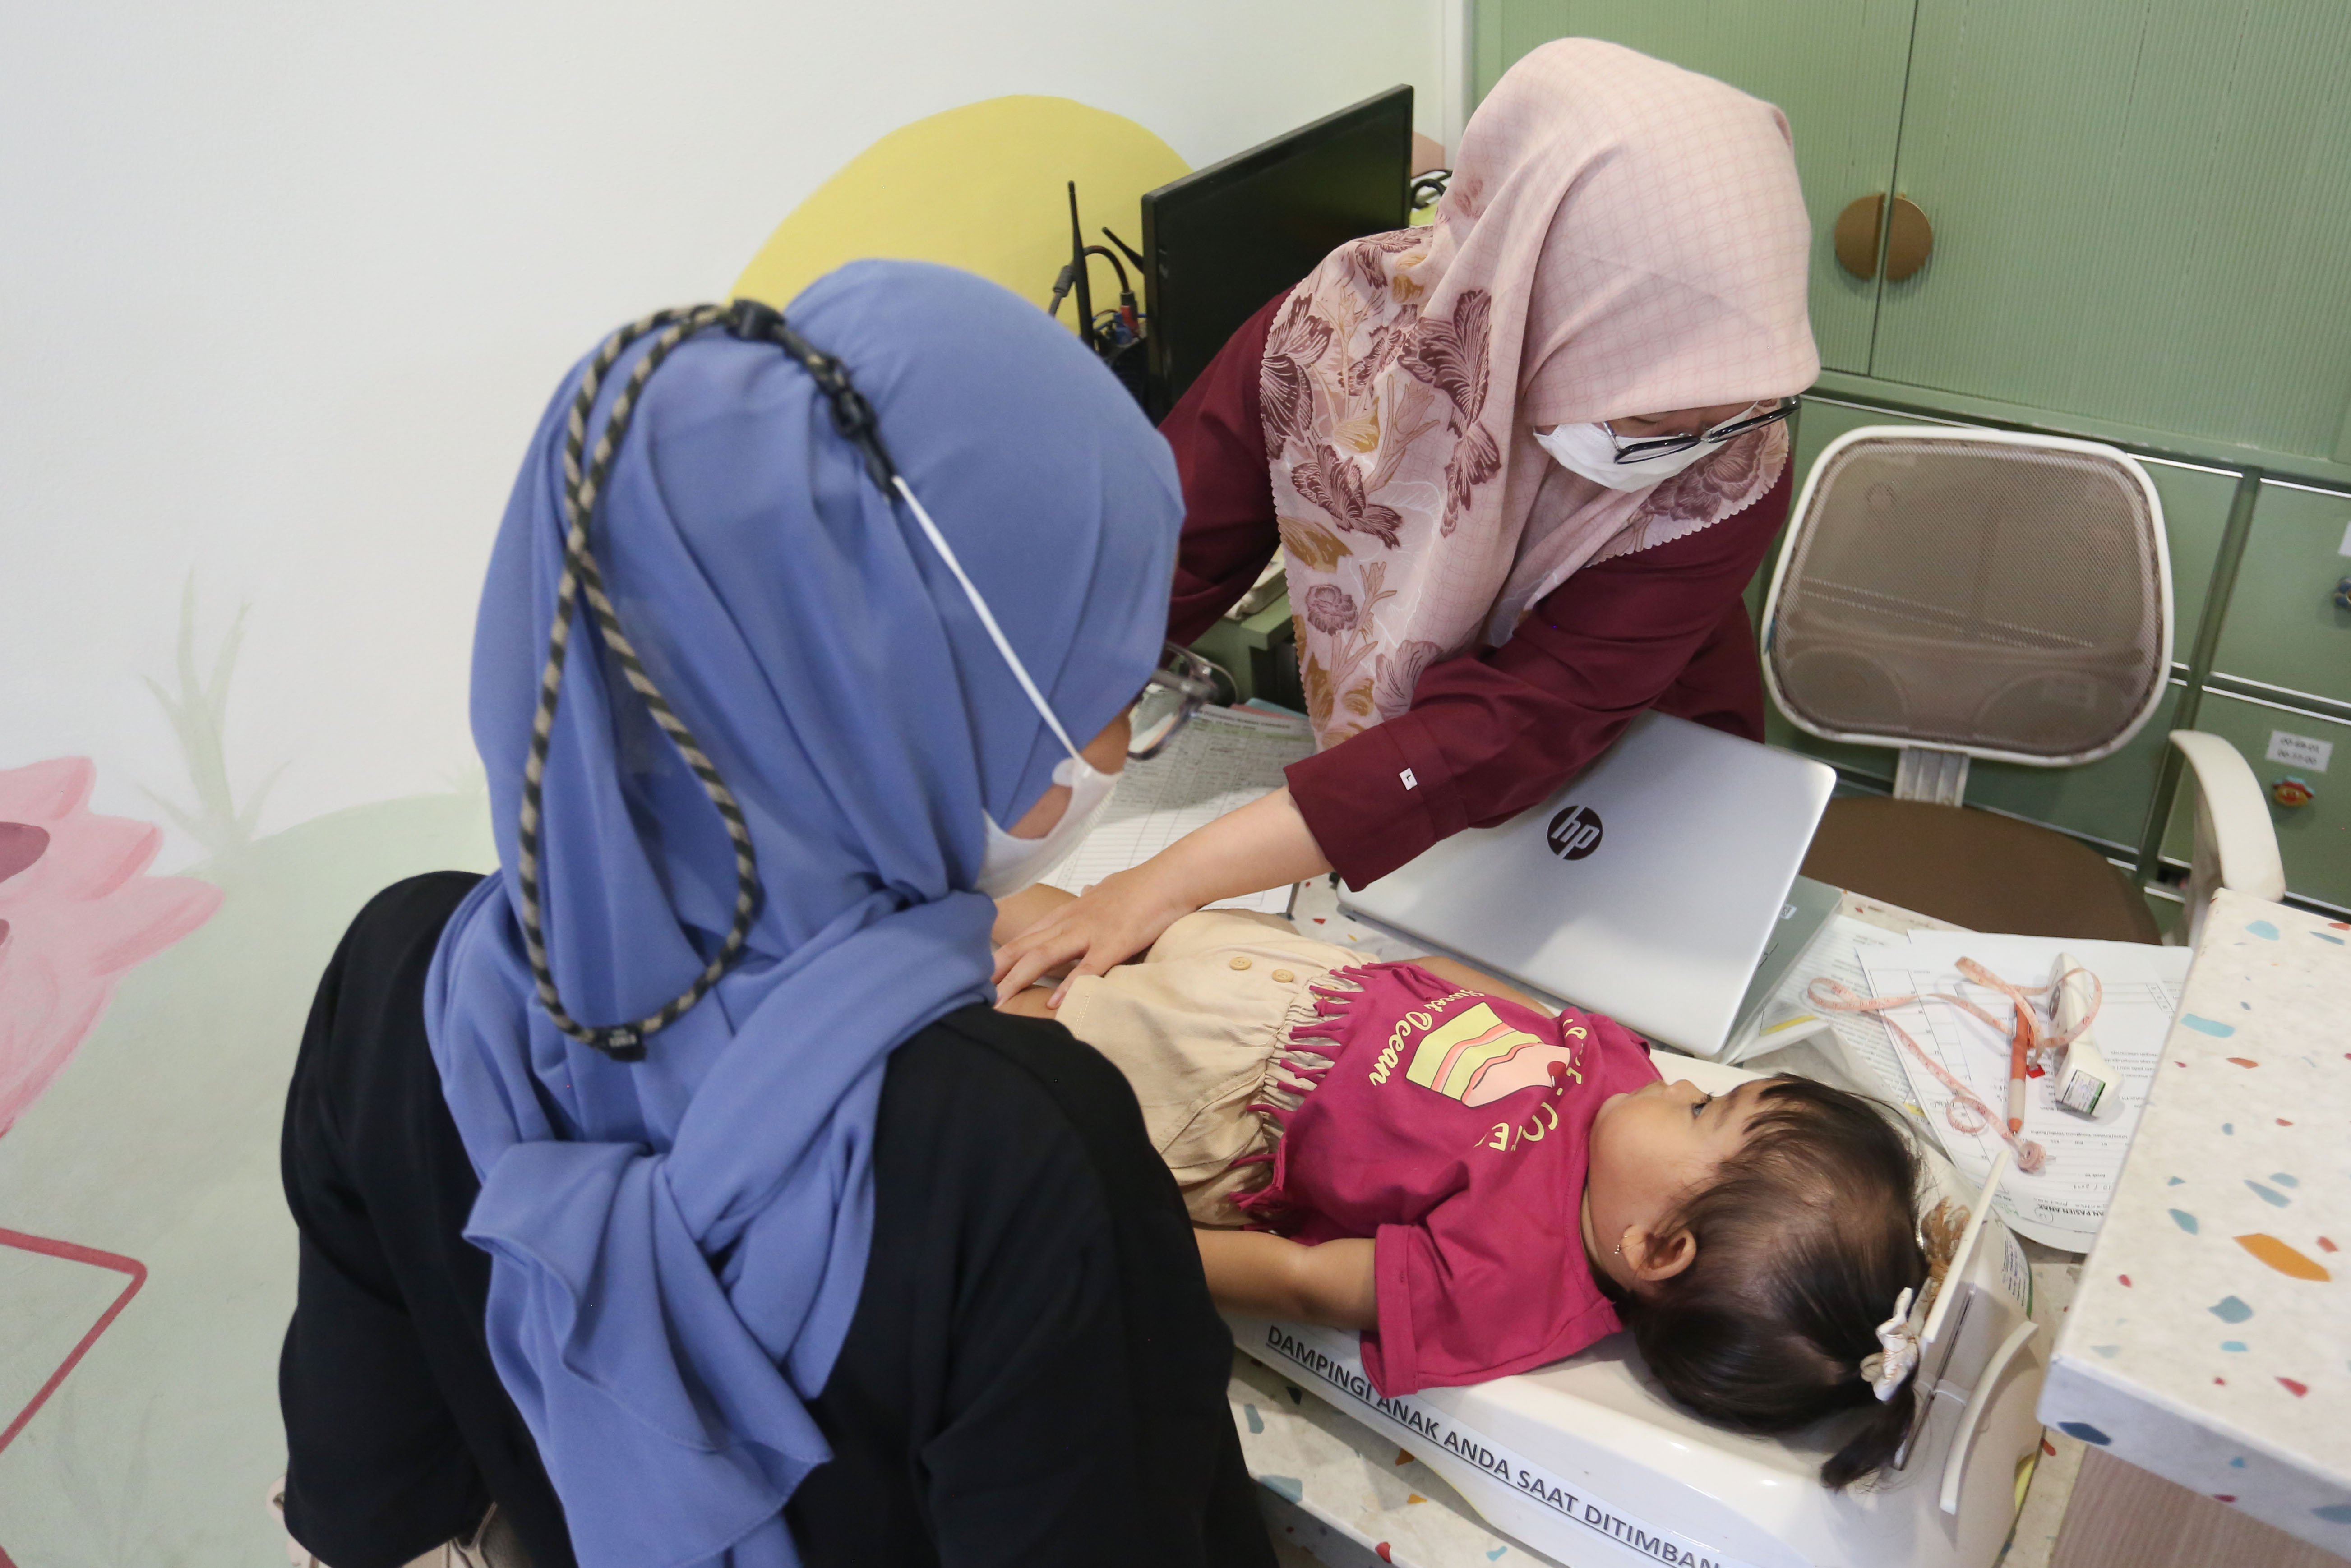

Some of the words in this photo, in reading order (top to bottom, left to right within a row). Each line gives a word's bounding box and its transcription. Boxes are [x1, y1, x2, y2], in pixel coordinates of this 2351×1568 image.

[1547, 805, 1603, 861] hp
[1424, 989, 1485, 1012] Sweet
[1369, 1011, 1433, 1086] Ocean
[2037, 1203, 2060, 1213] ANAK
[1268, 1325, 1373, 1402] DAMPINGI
[1376, 1397, 1439, 1439] ANAK
[1444, 1430, 1510, 1480] ANDA
[1517, 1469, 1579, 1512] SAAT
